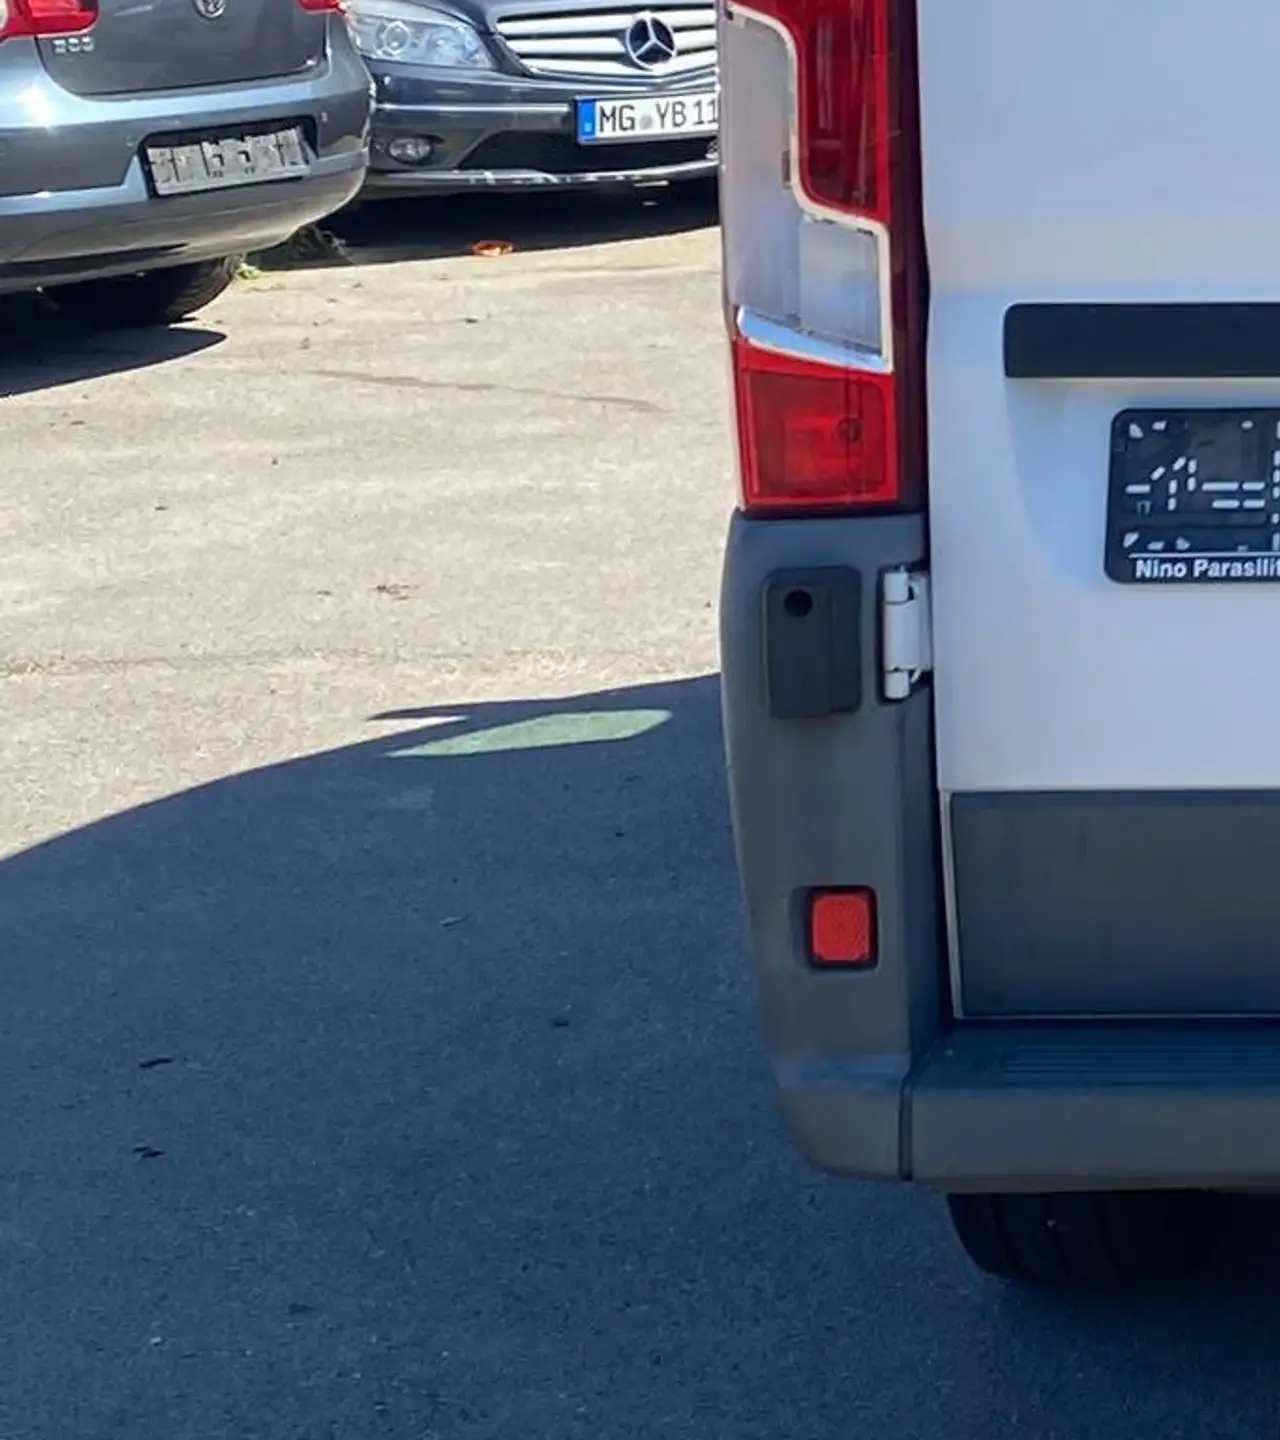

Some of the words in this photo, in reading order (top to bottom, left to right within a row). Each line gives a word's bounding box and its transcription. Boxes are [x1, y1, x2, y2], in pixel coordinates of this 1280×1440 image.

[600, 104, 635, 132] MG
[655, 100, 686, 128] YB
[1136, 559, 1187, 578] Nino
